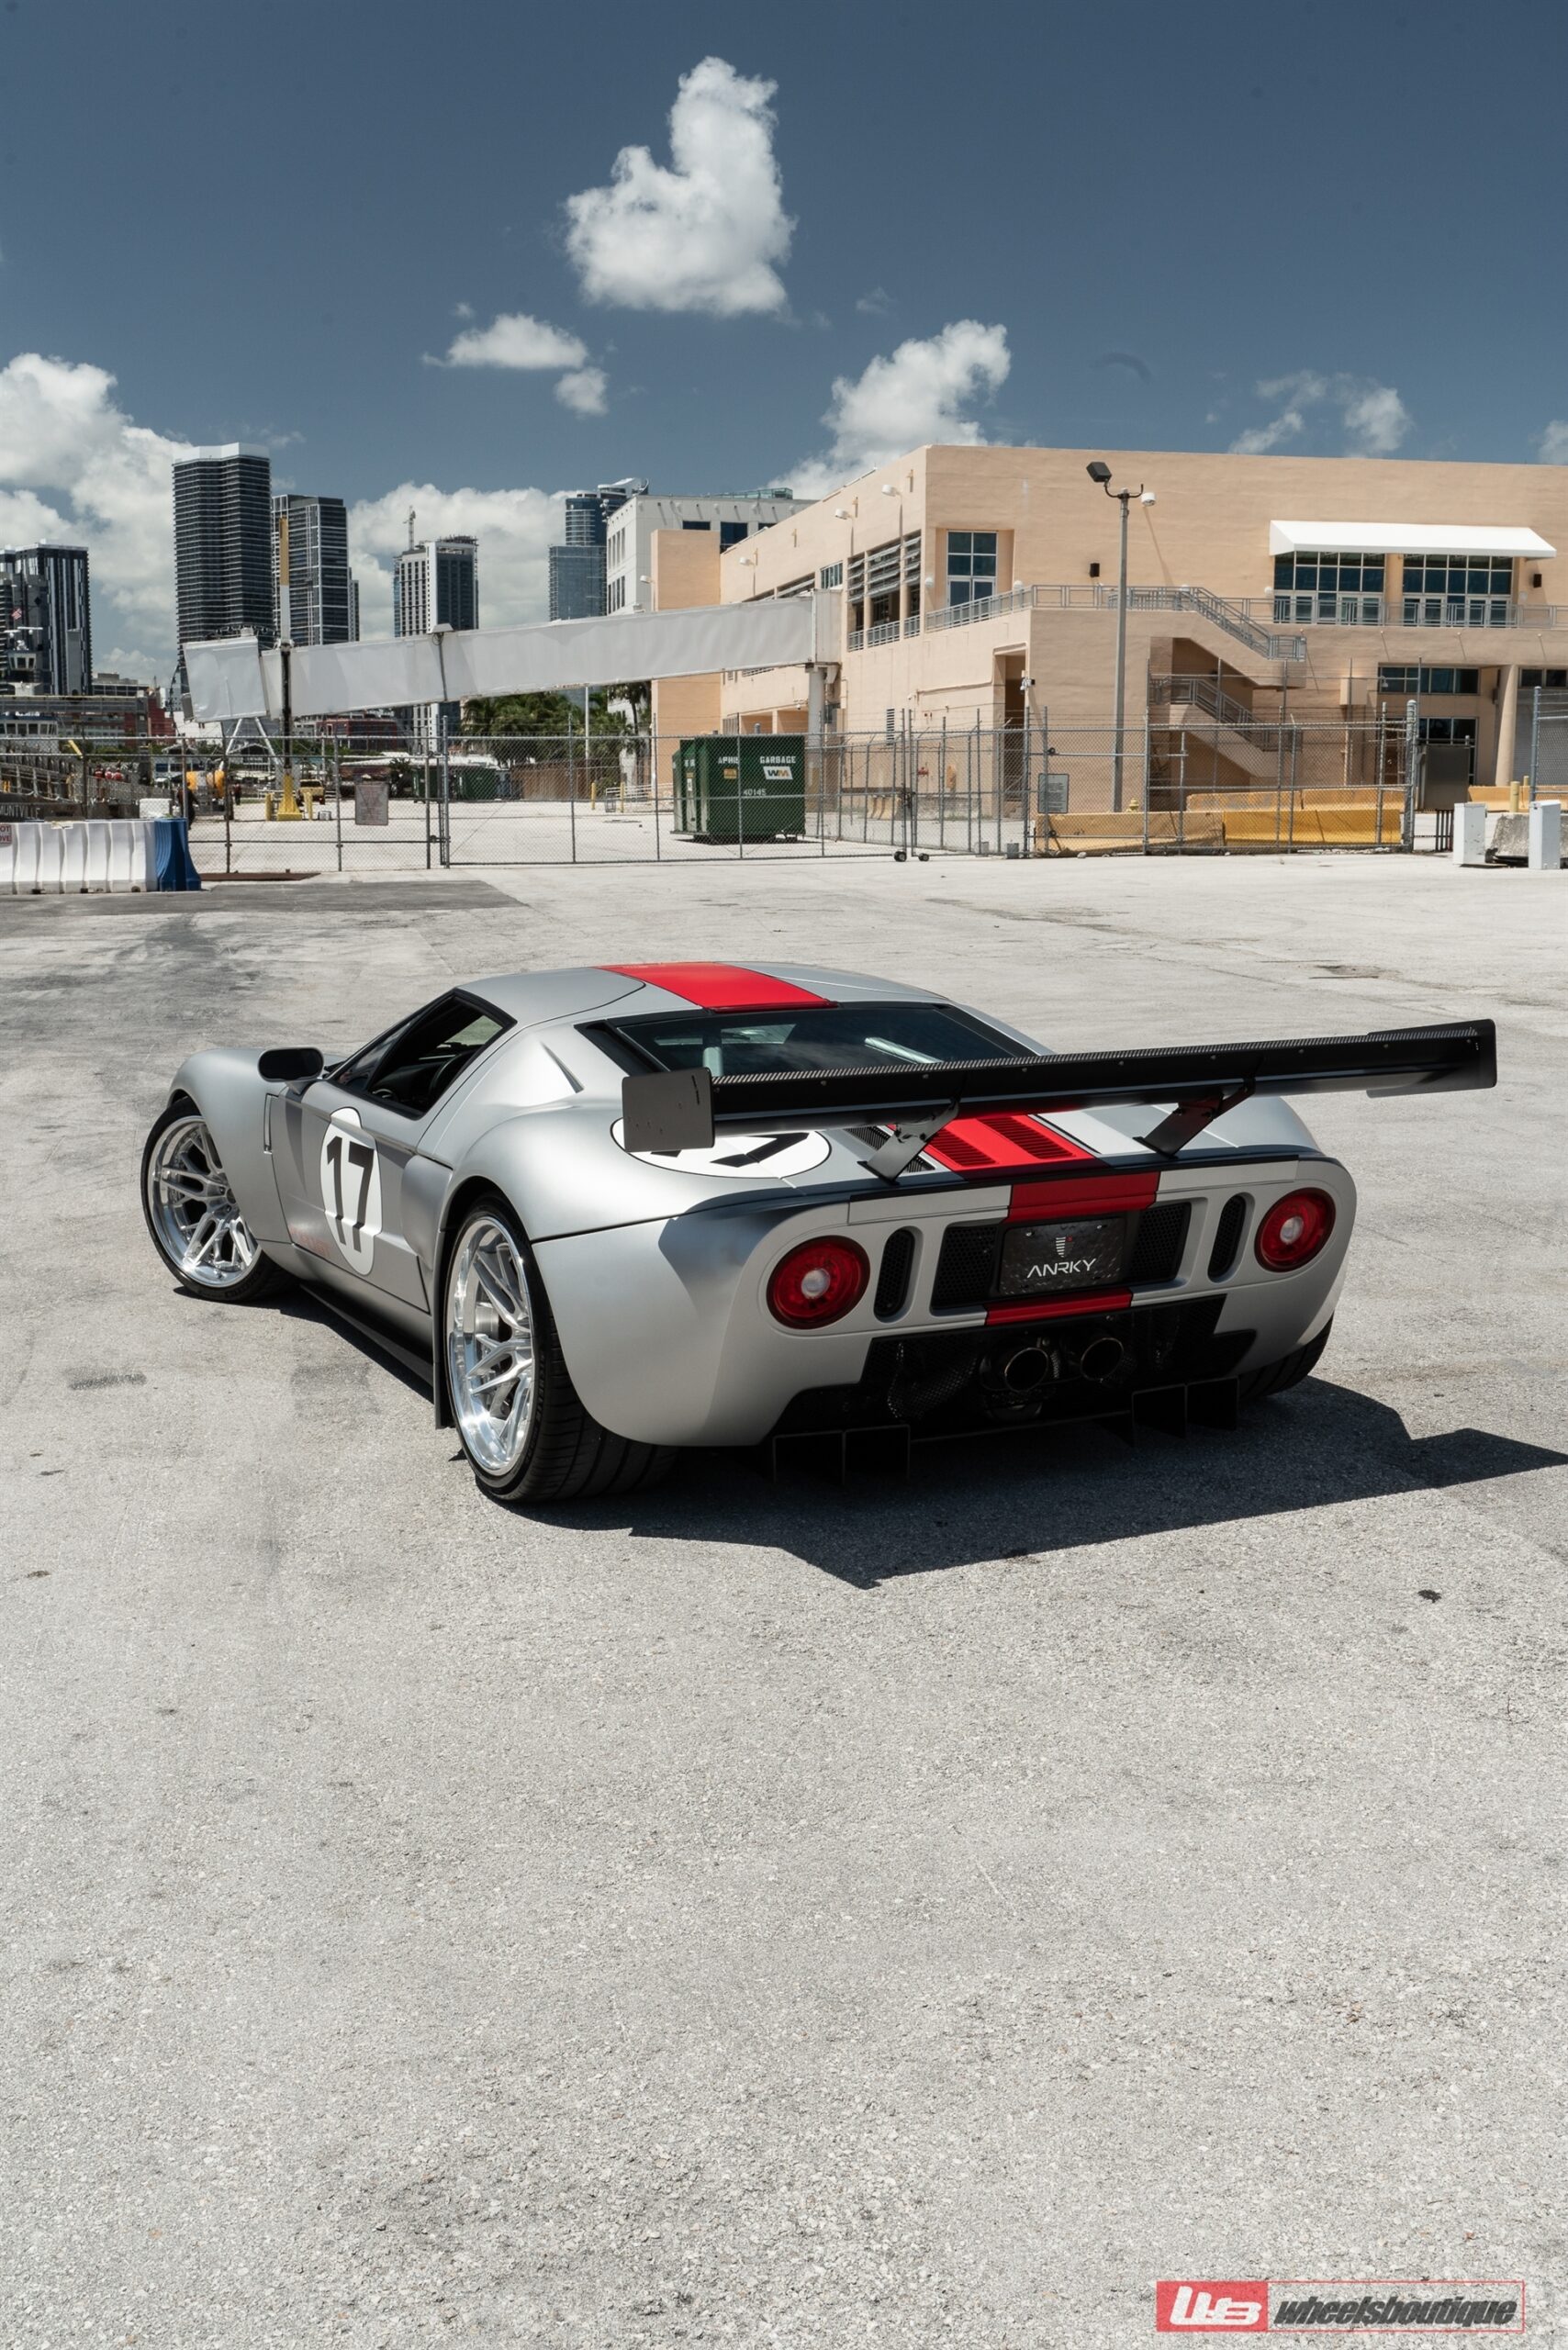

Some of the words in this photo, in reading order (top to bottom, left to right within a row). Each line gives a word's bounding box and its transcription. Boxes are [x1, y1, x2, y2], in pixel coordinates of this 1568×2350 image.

[759, 755, 797, 764] GARBAGE
[326, 1135, 375, 1254] 17
[1027, 1258, 1096, 1279] ANRKY
